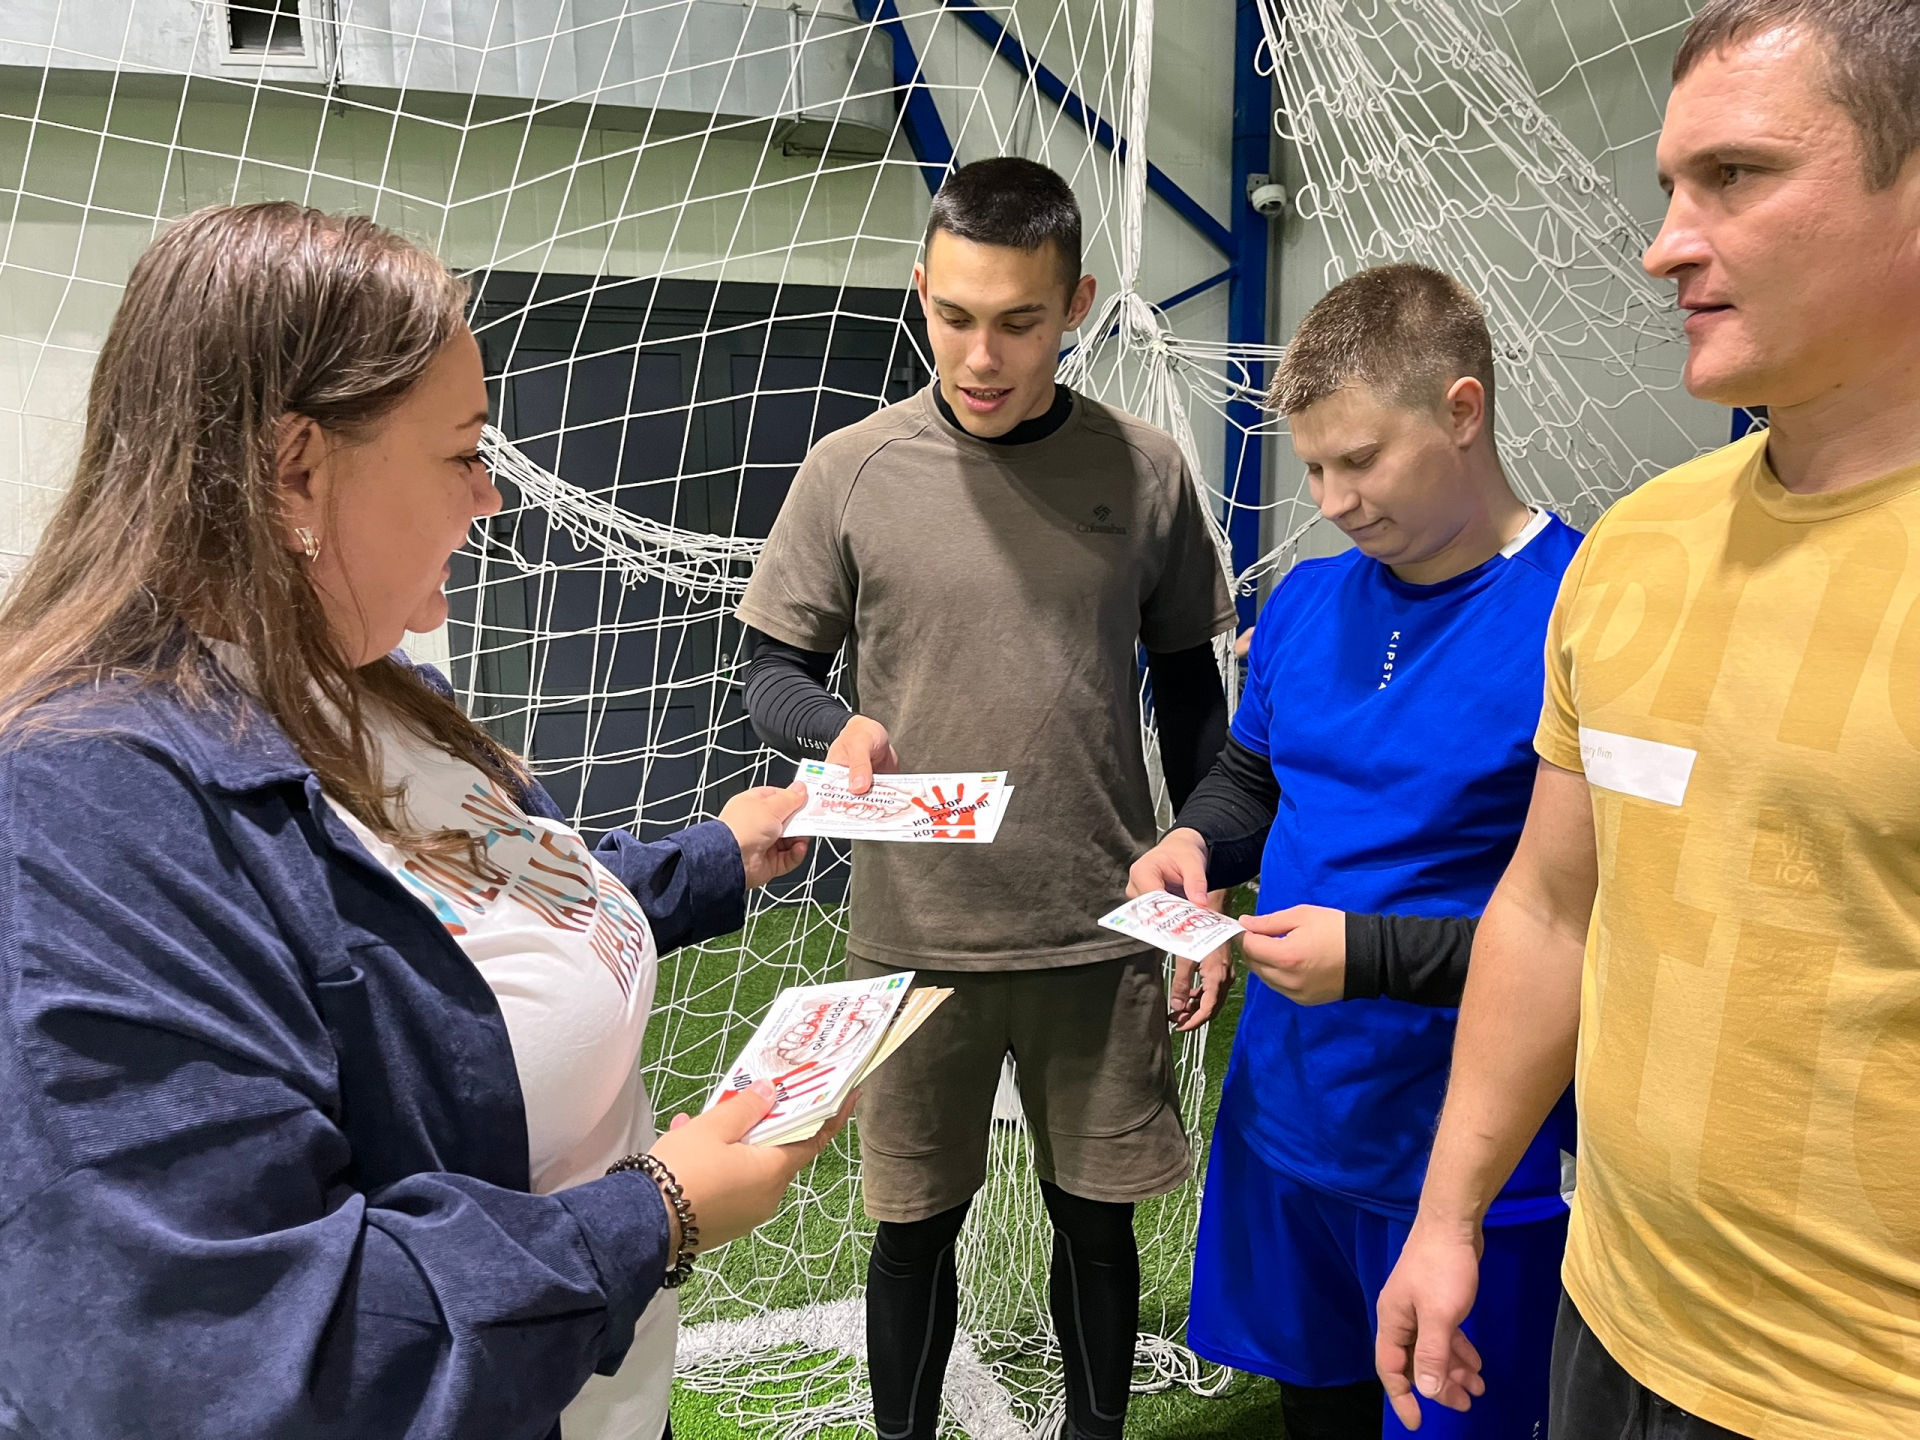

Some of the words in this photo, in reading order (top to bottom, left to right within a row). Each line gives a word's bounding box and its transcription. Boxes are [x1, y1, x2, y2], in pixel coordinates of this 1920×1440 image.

[1378, 631, 1401, 690] KIPSTA
[797, 736, 829, 751] KIPSTA
[816, 791, 895, 804] коррупцию
[931, 798, 962, 812] STOP
[813, 996, 851, 1051] коррупцию
